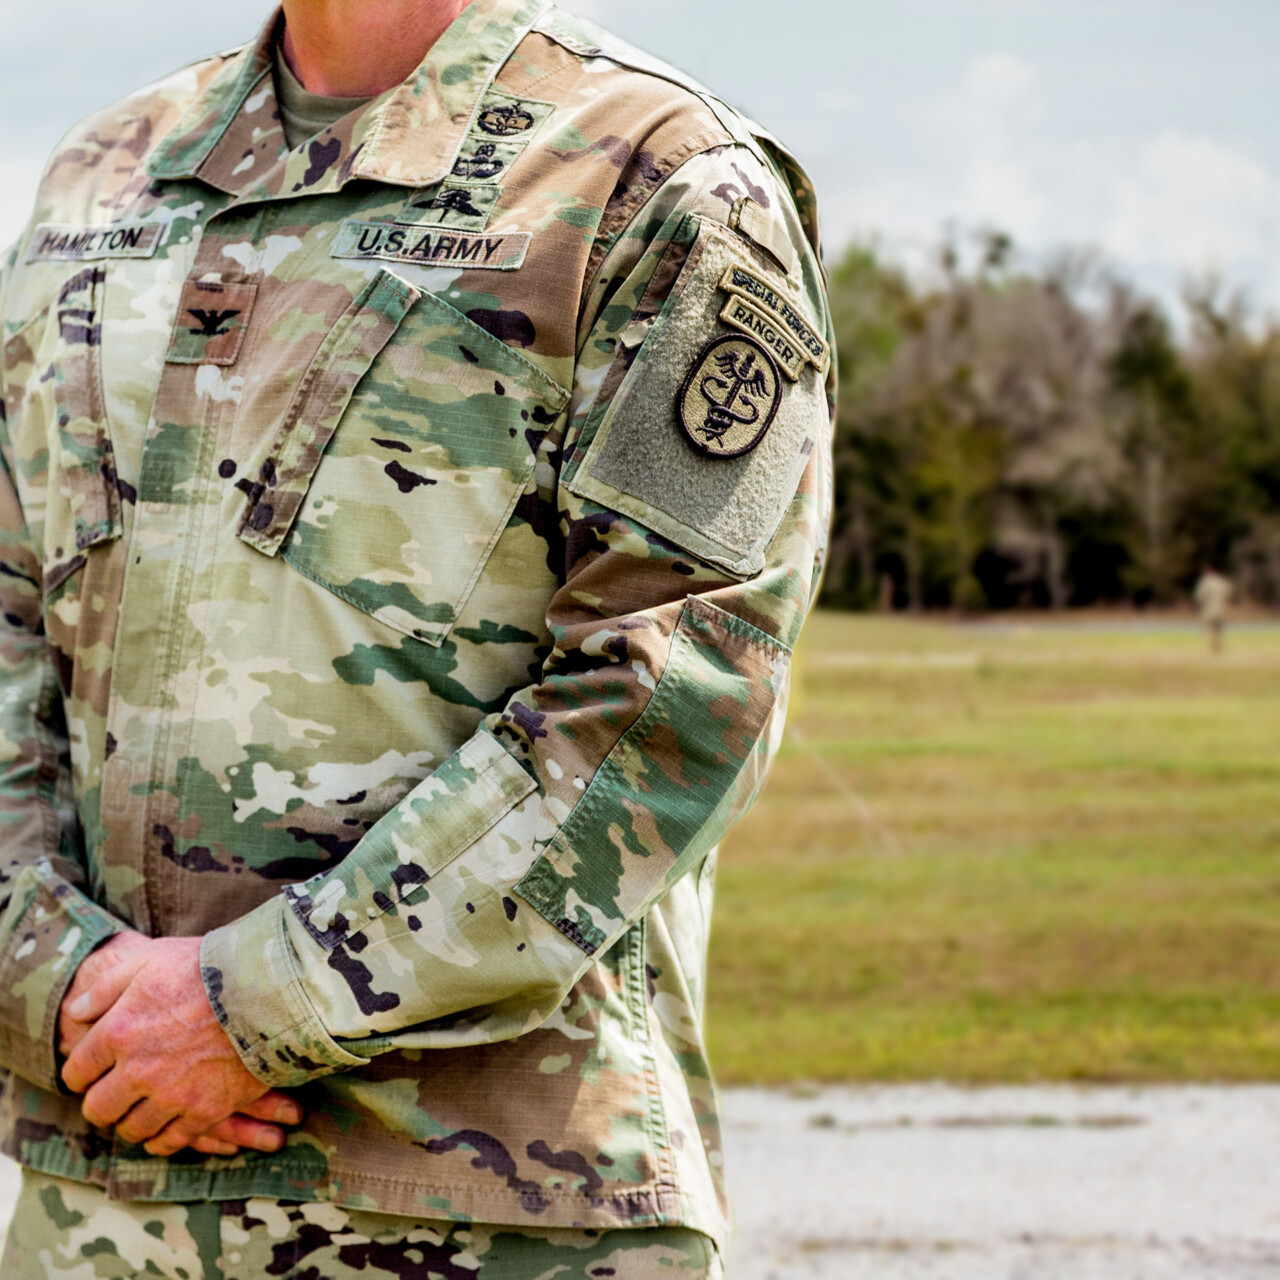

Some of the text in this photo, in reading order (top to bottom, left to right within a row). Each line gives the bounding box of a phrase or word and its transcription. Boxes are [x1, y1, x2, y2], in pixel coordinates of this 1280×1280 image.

[38, 227, 144, 254] HAMILTON
[732, 269, 825, 357] SPECIAL FORCES
[732, 306, 795, 364] RANGER
